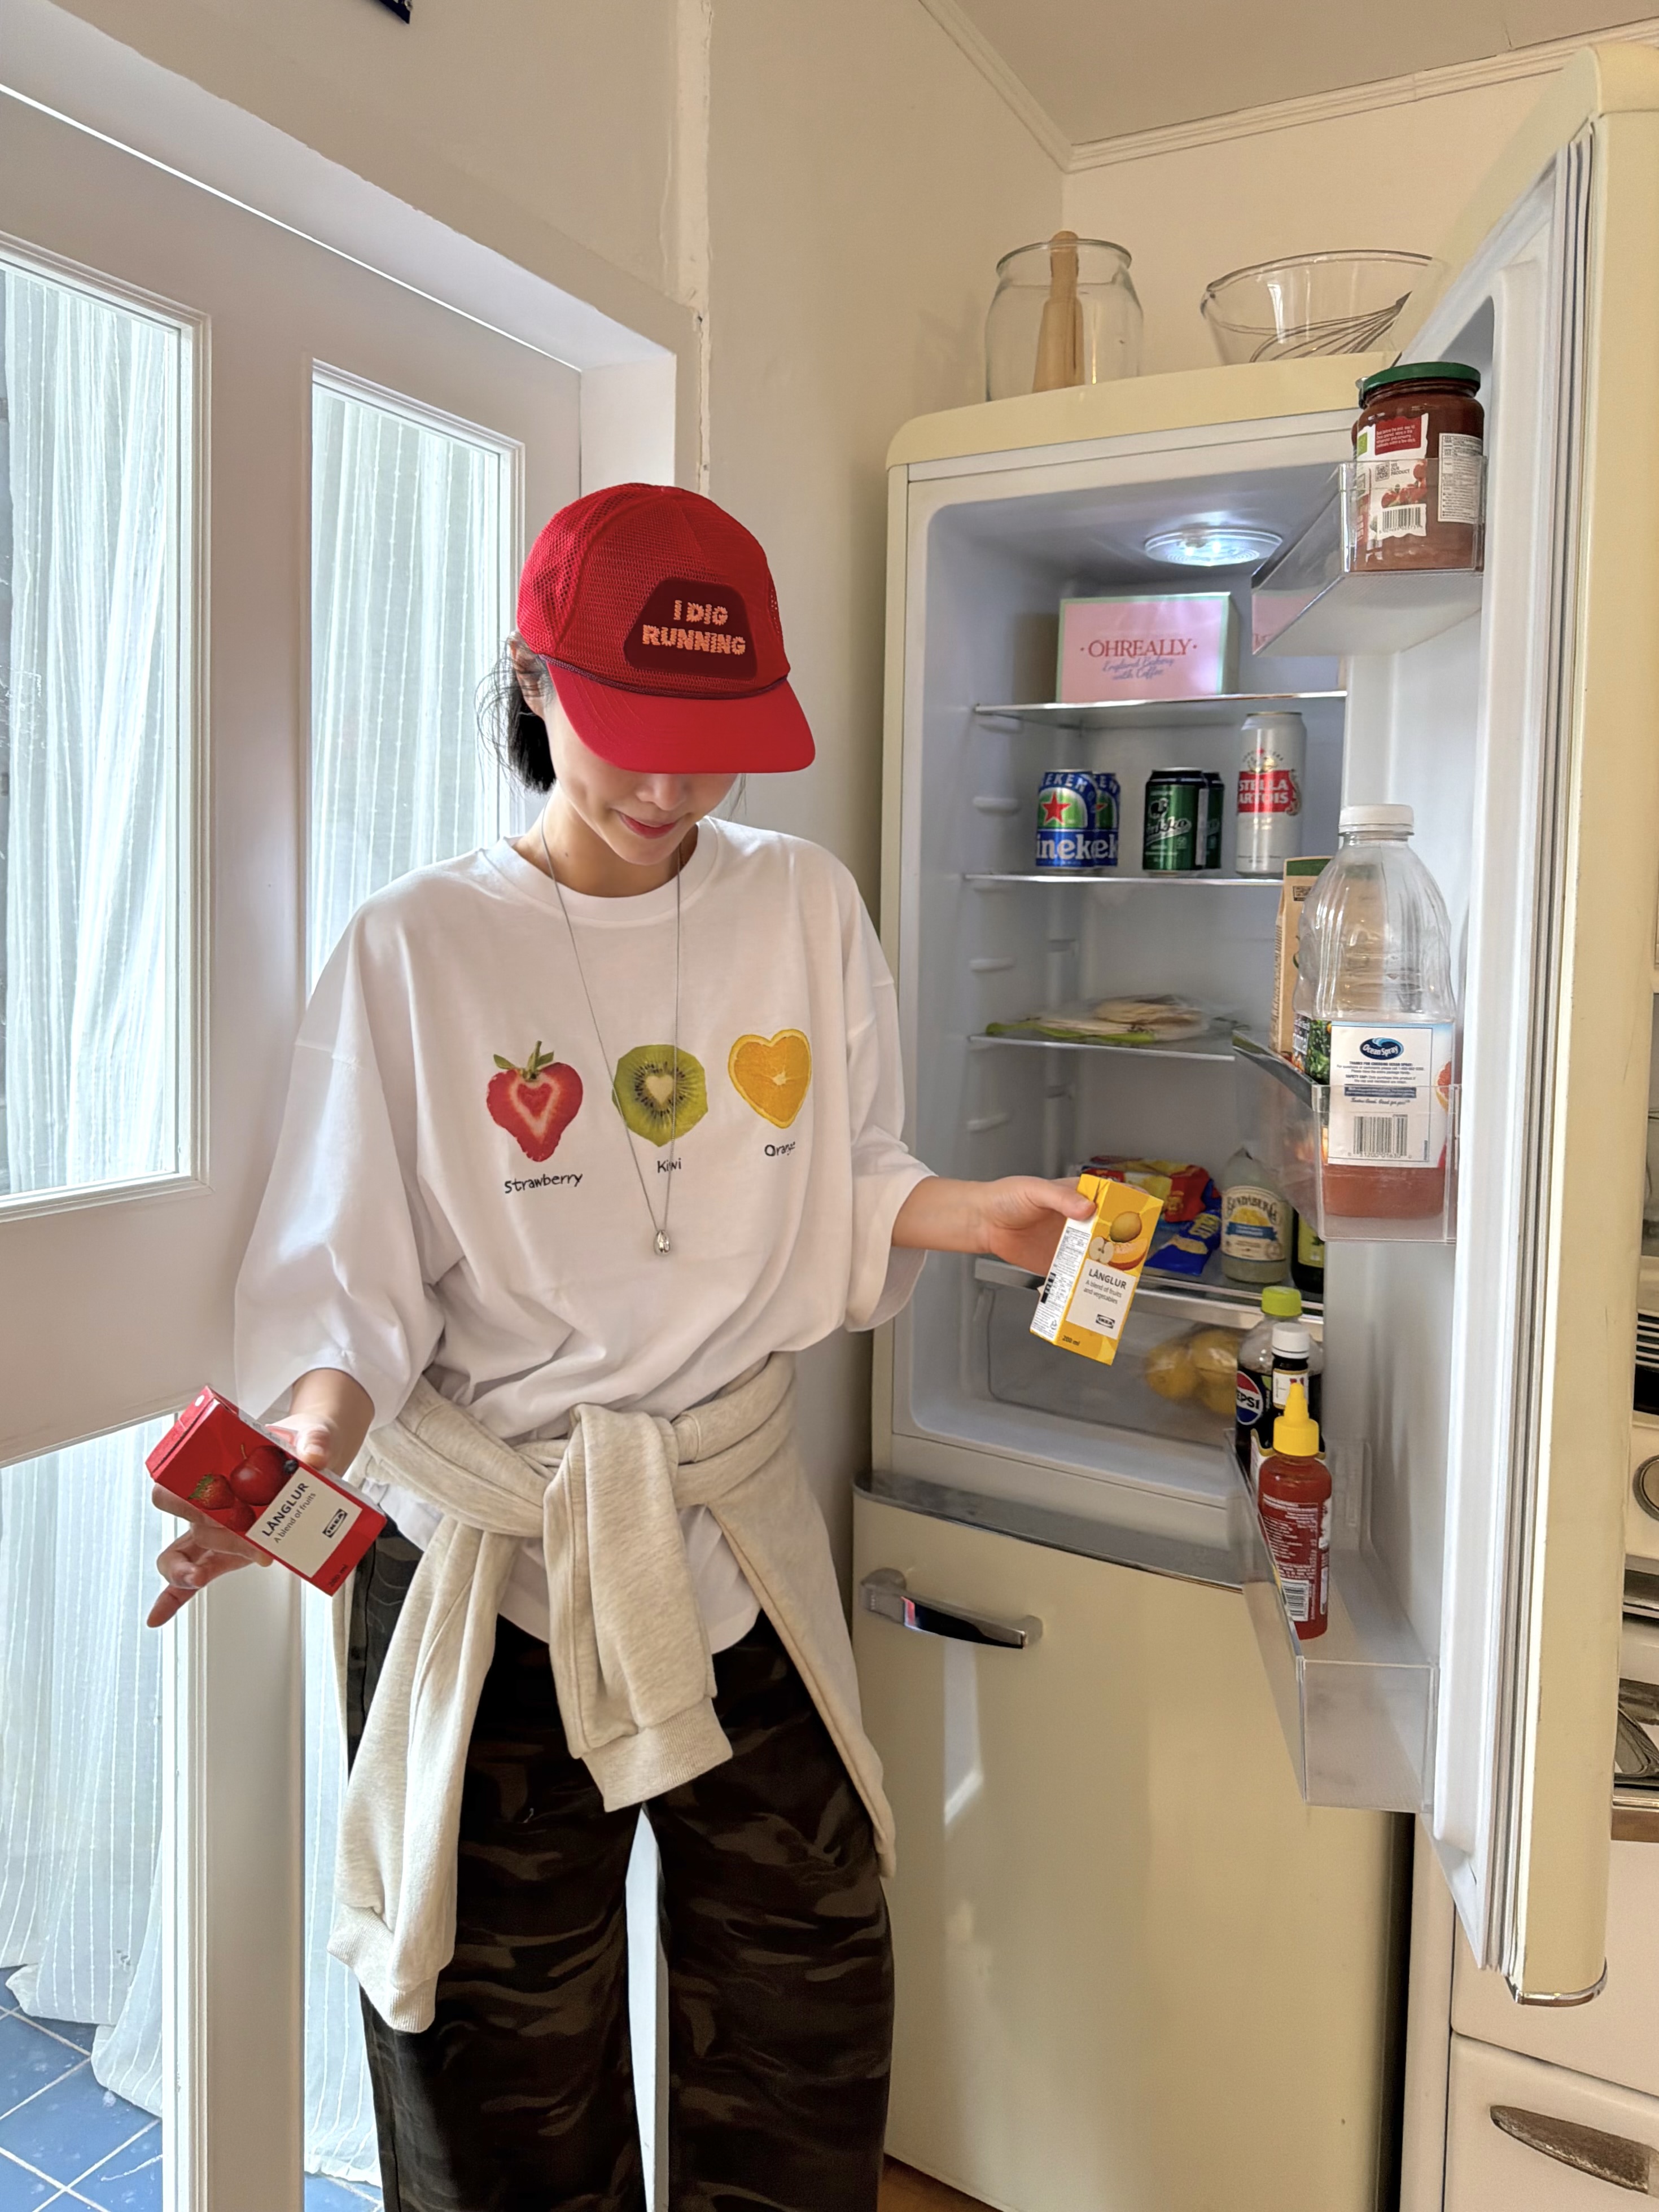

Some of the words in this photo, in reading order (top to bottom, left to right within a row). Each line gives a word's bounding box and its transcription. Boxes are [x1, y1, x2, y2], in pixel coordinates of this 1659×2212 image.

[673, 600, 682, 620] I
[686, 602, 728, 626] DIG
[642, 624, 746, 655] RUNNING
[1088, 638, 1192, 658] OHREALLY
[1042, 773, 1088, 792] EKEN
[1238, 779, 1288, 791] STELLA
[1363, 1044, 1381, 1055] Ocean
[1381, 1045, 1399, 1057] Spray
[764, 1141, 795, 1157] Oran
[657, 1158, 681, 1173] Kiwi
[1090, 1281, 1104, 1291] blend
[1109, 1287, 1122, 1298] fruits
[1093, 1291, 1118, 1304] vegetables
[1098, 1317, 1113, 1326] IKEA
[1237, 1390, 1259, 1409] EPSI
[278, 1517, 297, 1538] blend
[295, 1509, 303, 1518] of
[300, 1492, 317, 1511] fruits
